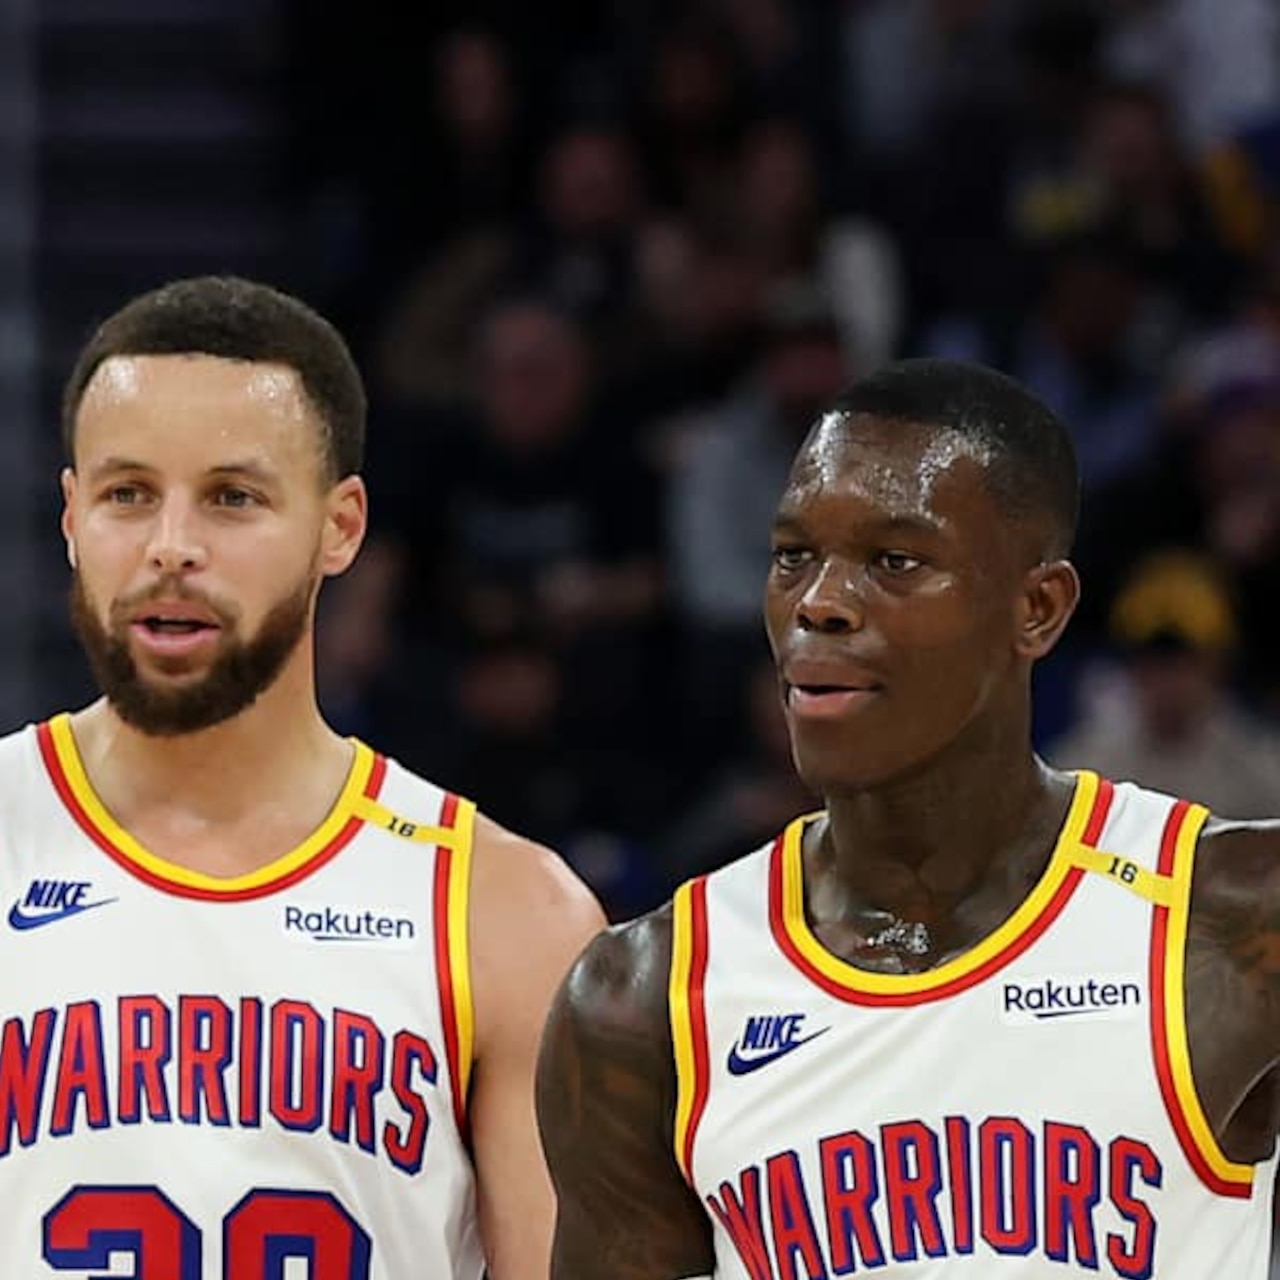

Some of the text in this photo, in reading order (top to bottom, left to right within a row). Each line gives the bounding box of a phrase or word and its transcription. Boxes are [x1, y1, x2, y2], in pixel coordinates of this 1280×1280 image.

[388, 816, 417, 837] 16
[1108, 857, 1138, 884] 16
[23, 880, 91, 908] NIKE
[285, 905, 415, 940] Rakuten
[1004, 979, 1141, 1012] Rakuten
[741, 1013, 806, 1050] NIKE
